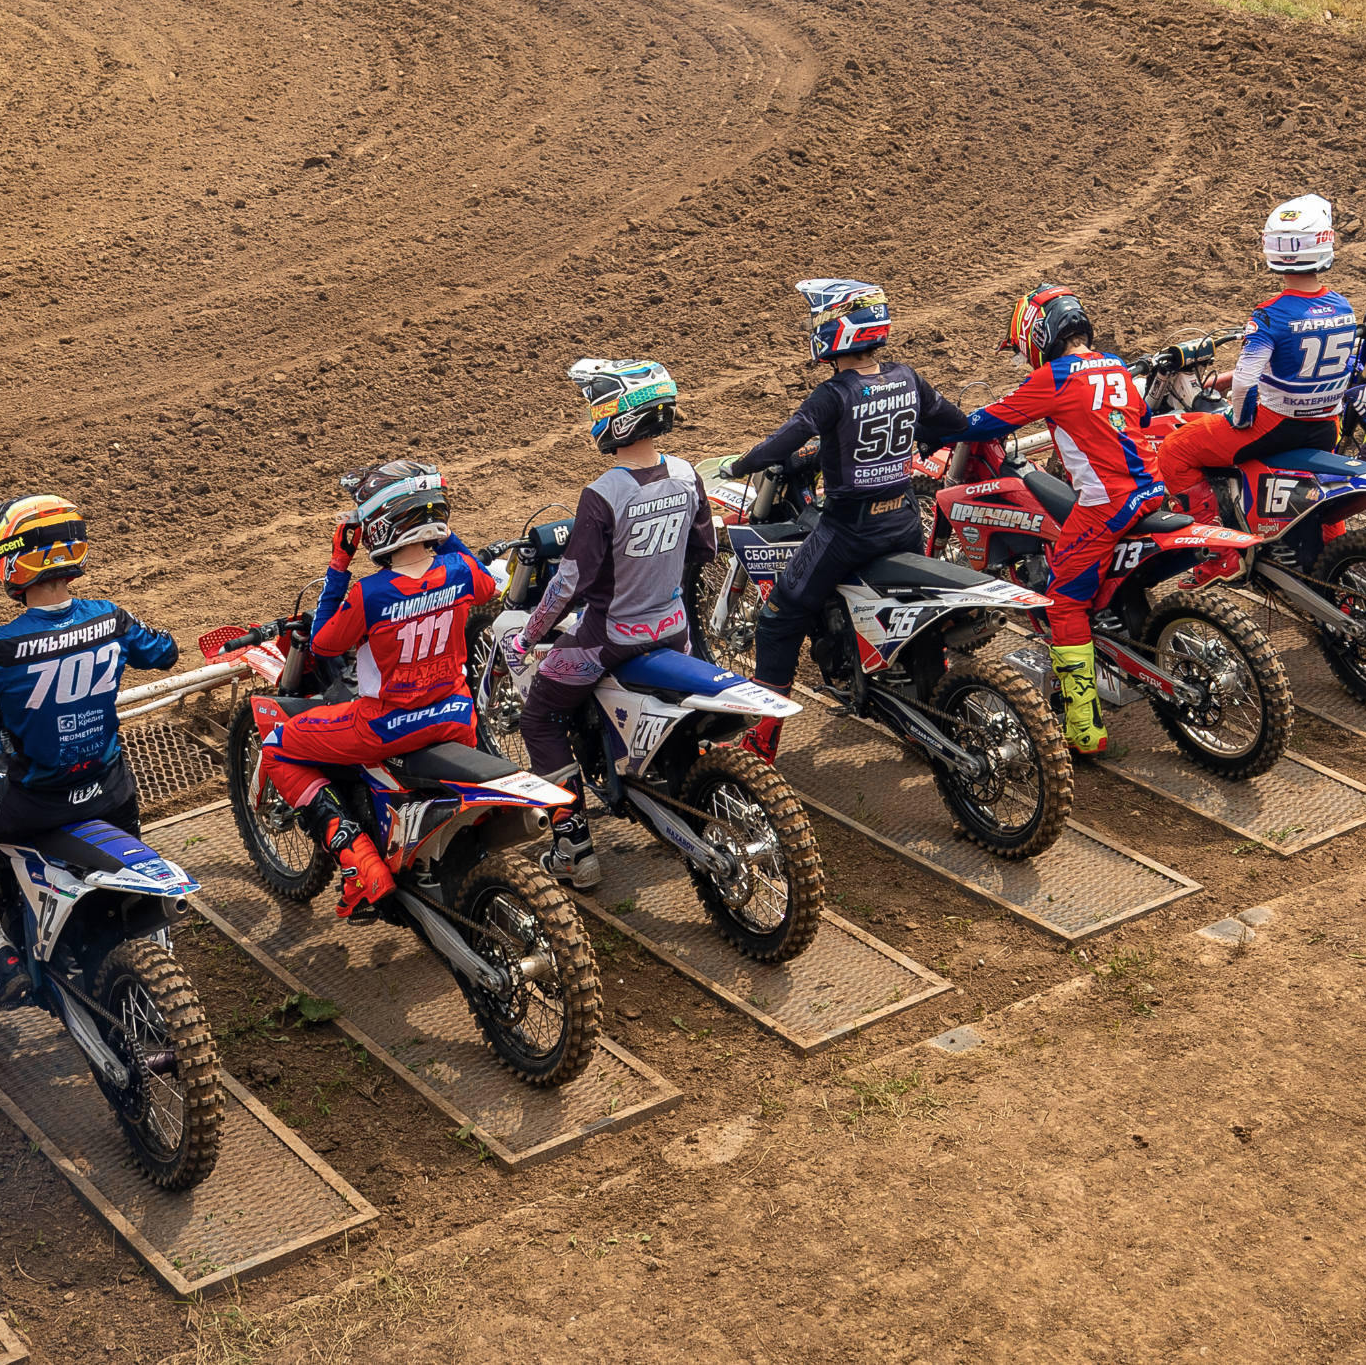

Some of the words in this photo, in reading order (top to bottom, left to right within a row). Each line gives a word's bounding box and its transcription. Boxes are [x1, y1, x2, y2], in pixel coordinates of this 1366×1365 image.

[1068, 356, 1123, 373] ПАВЛОВ
[1298, 331, 1355, 378] 15
[852, 391, 917, 419] ТРОФИМОВ
[1088, 372, 1128, 411] 73
[853, 408, 917, 463] 56
[854, 472, 904, 485] САНКТ-ПЕТЕРБУРГА
[855, 462, 902, 478] СБОРНАЯ
[965, 480, 1000, 495] СТДК
[1265, 478, 1299, 513] 15
[627, 492, 688, 520] DOVYDENKO
[950, 502, 1046, 533] ПРИМОРЬЕ
[624, 510, 686, 558] 278
[1174, 536, 1208, 545] СТДК
[1113, 541, 1143, 572] 73
[390, 585, 457, 622] САМОЙЛЕНКО
[397, 610, 454, 663] 111
[886, 607, 924, 640] 56
[15, 617, 117, 659] ЛУКЬЯНЧЕНКО
[25, 642, 121, 710] 702
[392, 656, 458, 682] MILYAEV
[416, 669, 453, 688] SCHOOL
[1139, 672, 1163, 689] СТДК
[78, 709, 103, 719] Кубань
[79, 715, 104, 726] Кредит
[387, 701, 469, 730] UFOPLAST
[59, 725, 103, 742] НЕОМЕТРИЯ
[634, 713, 667, 751] 278
[80, 740, 104, 754] ALIAS
